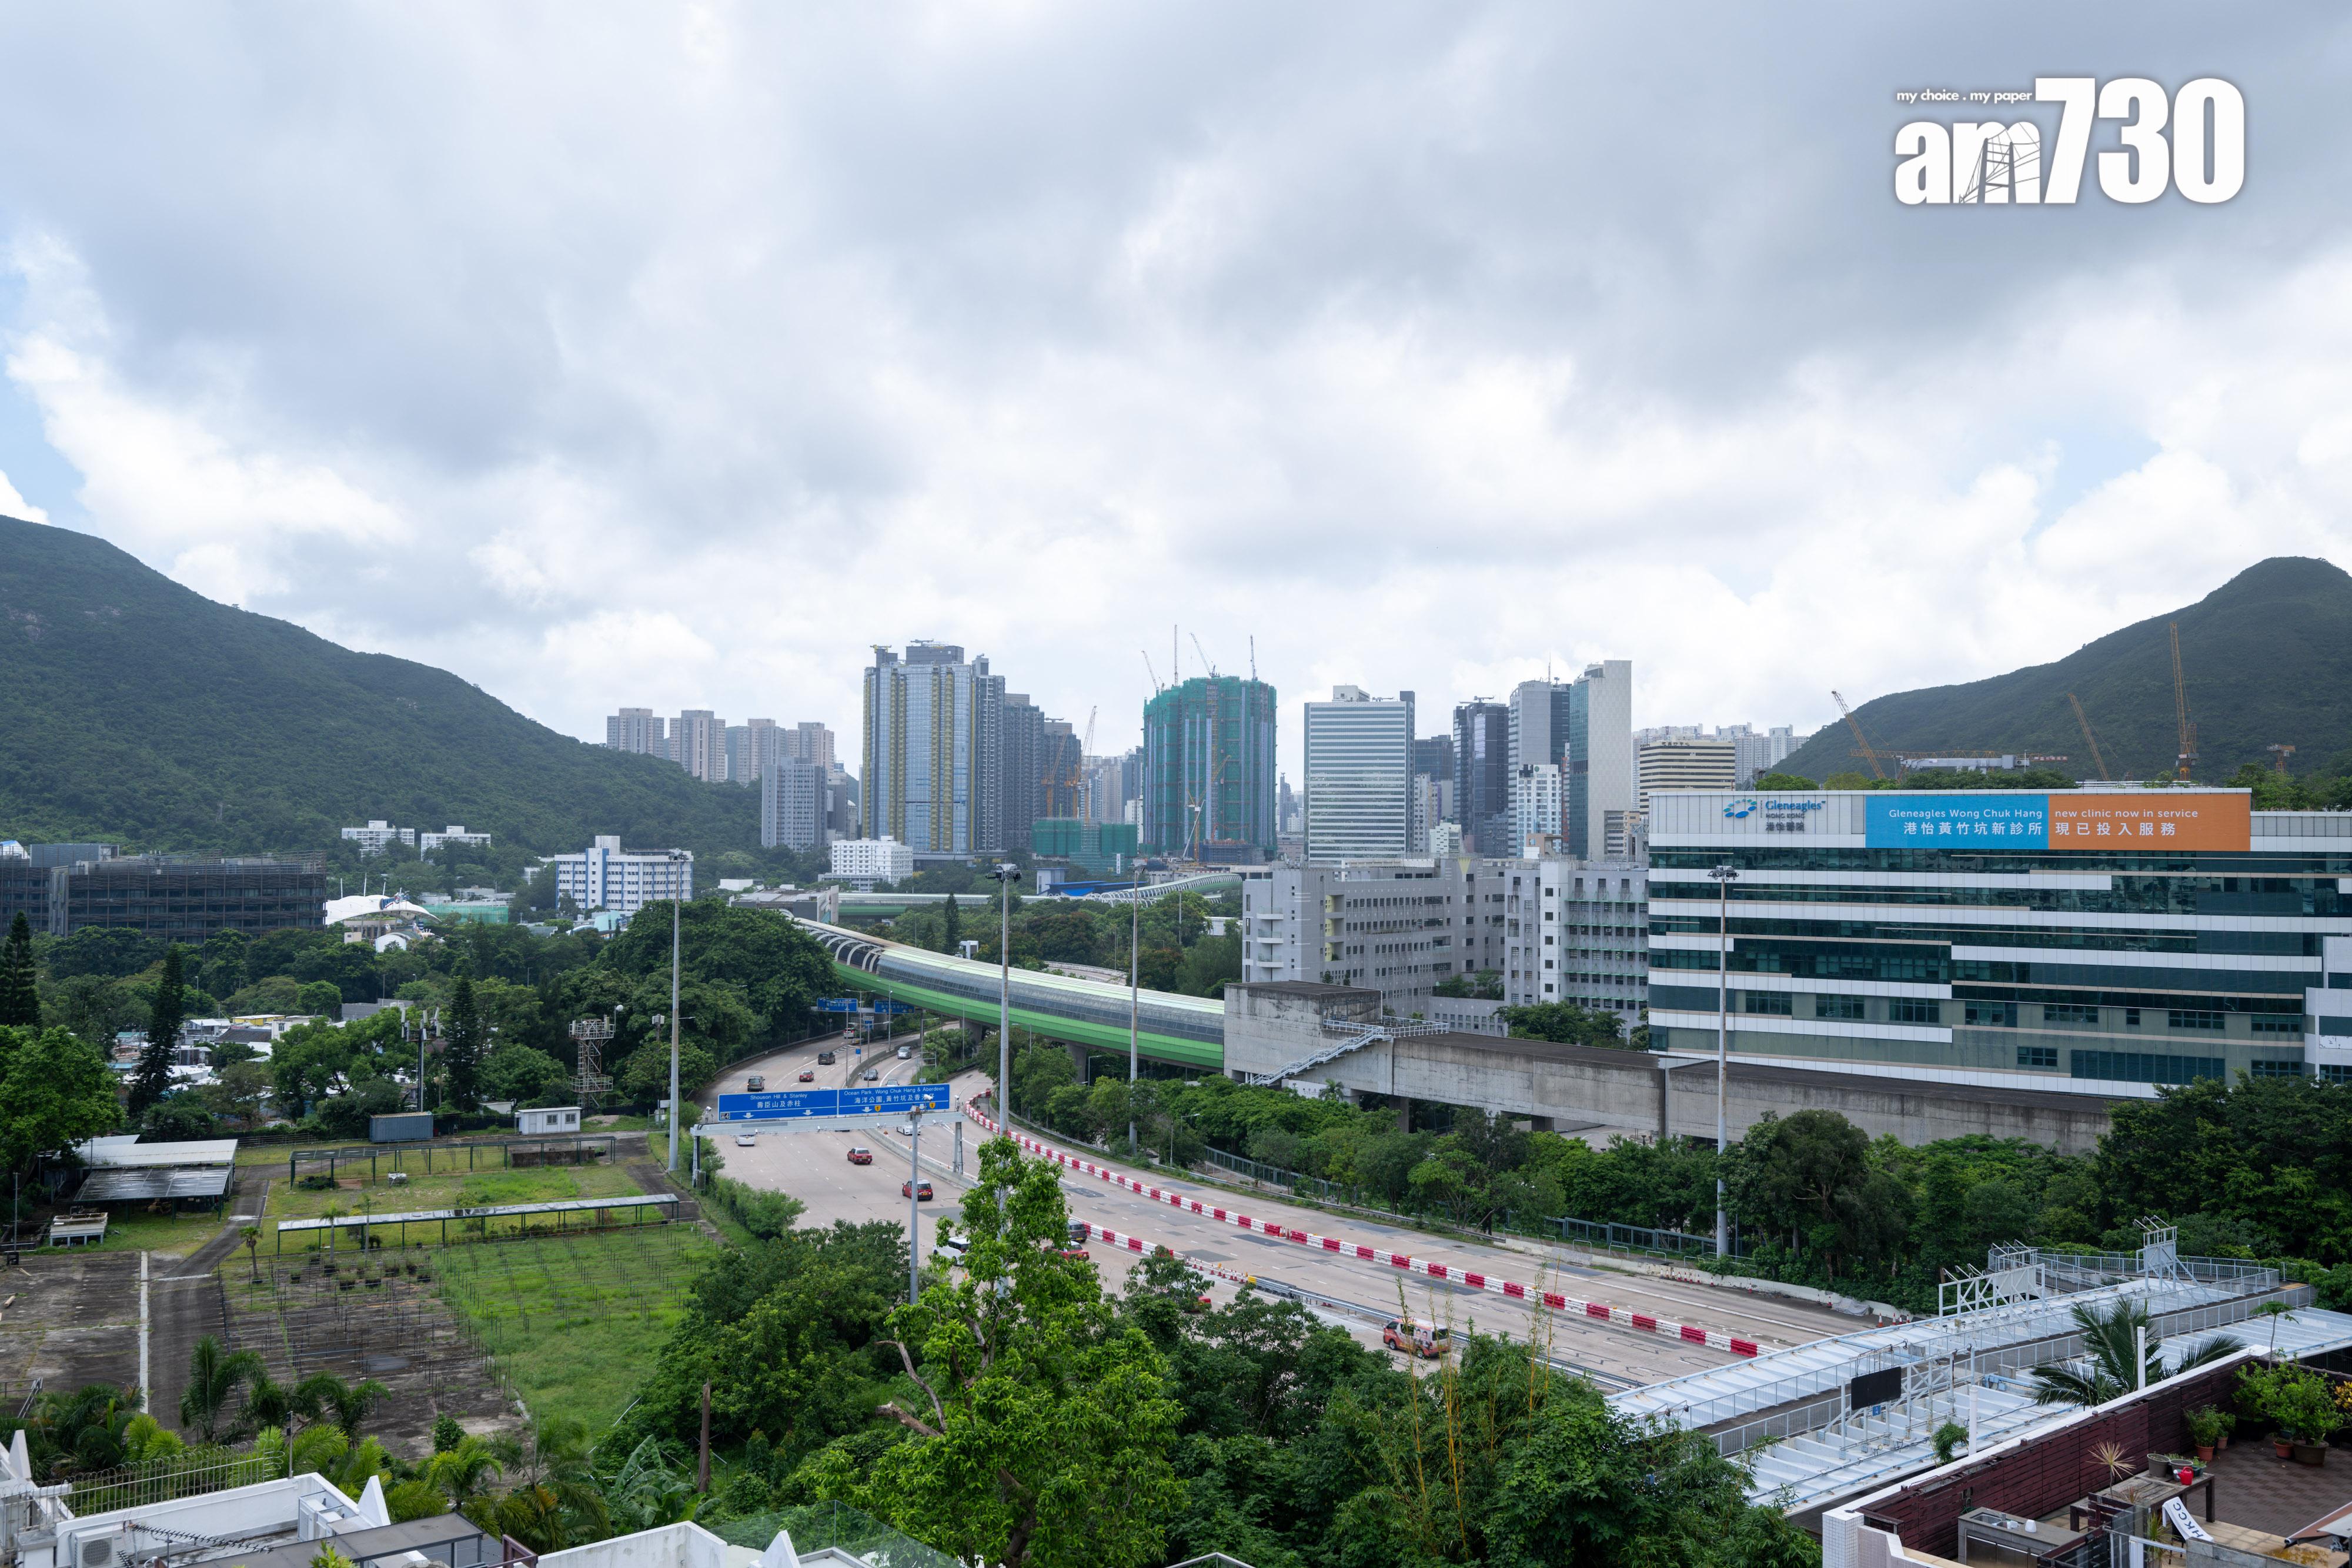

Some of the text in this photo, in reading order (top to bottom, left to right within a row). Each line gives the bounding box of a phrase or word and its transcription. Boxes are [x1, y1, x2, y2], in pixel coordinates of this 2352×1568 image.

[1765, 800, 1822, 813] Gleneagles
[1889, 810, 1946, 819] Gleneagles
[1949, 810, 1979, 819] Wong
[2014, 810, 2042, 819] Hang
[2081, 809, 2111, 818] clinic
[2143, 809, 2153, 818] in
[2158, 809, 2198, 818] service
[1904, 821, 2042, 835] 港怡黃竹坑新診所
[2055, 822, 2176, 836] 現已投入服務
